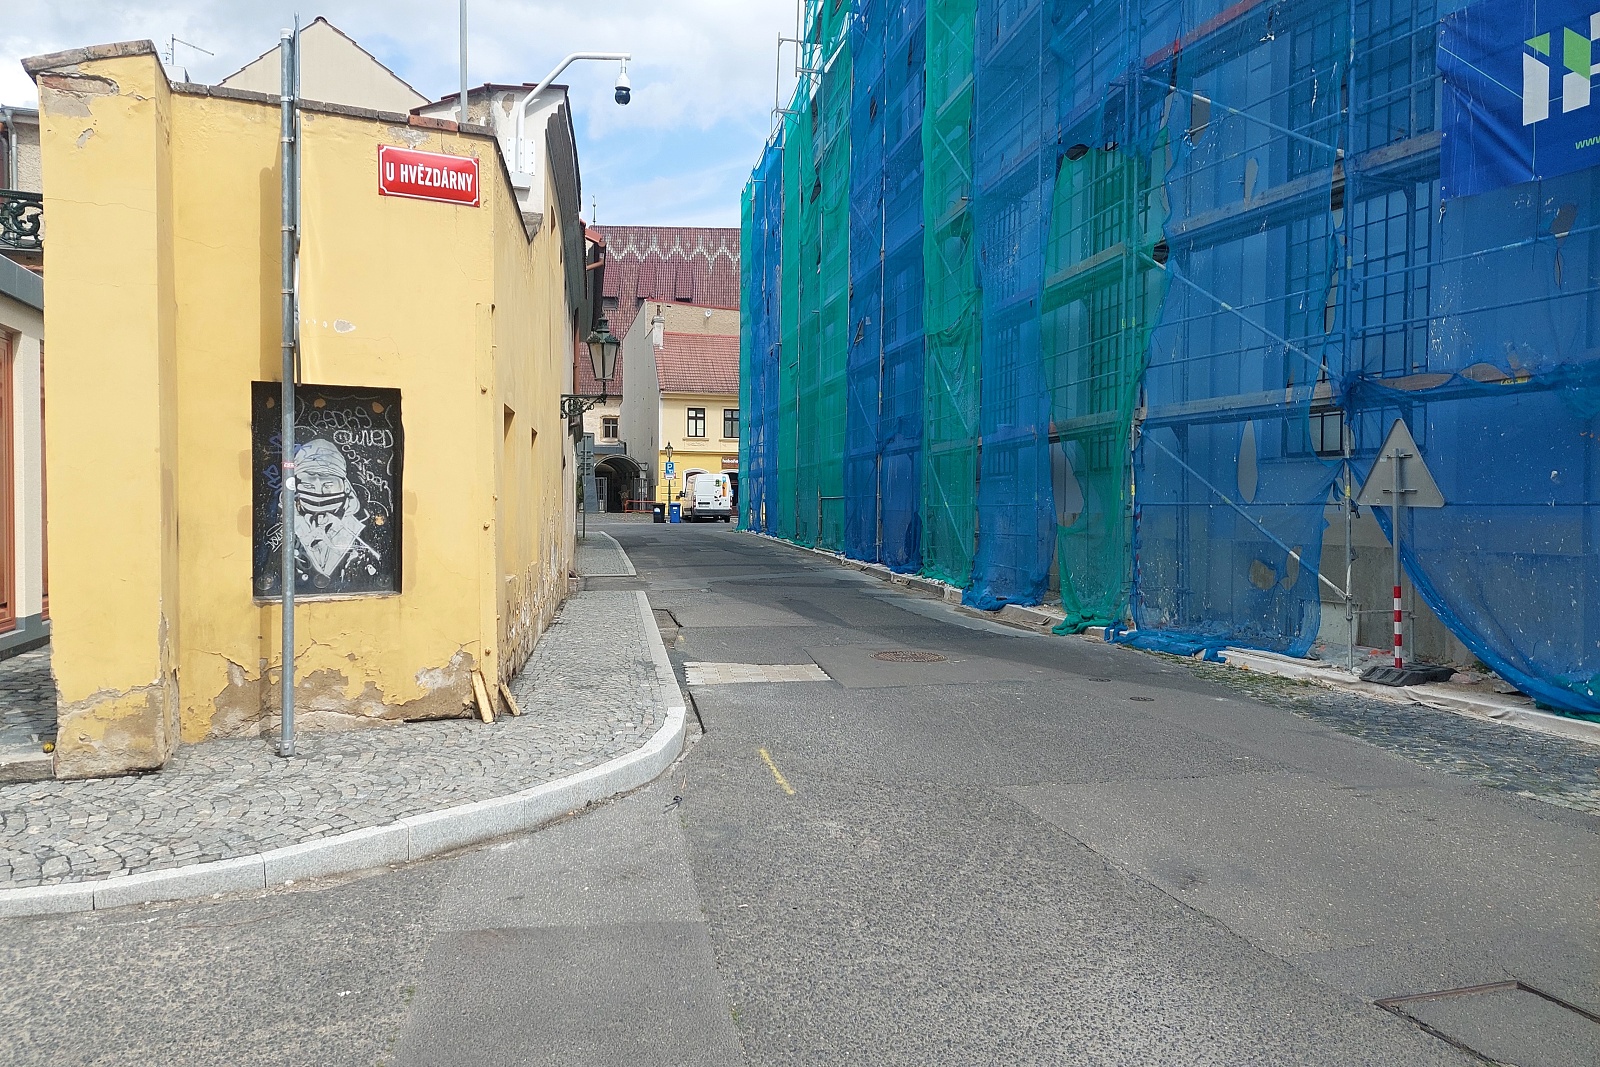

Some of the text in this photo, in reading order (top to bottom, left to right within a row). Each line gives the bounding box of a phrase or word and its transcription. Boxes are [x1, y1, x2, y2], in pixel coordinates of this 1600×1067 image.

[386, 162, 473, 192] U HVĚZDÁRNY
[667, 463, 673, 471] P
